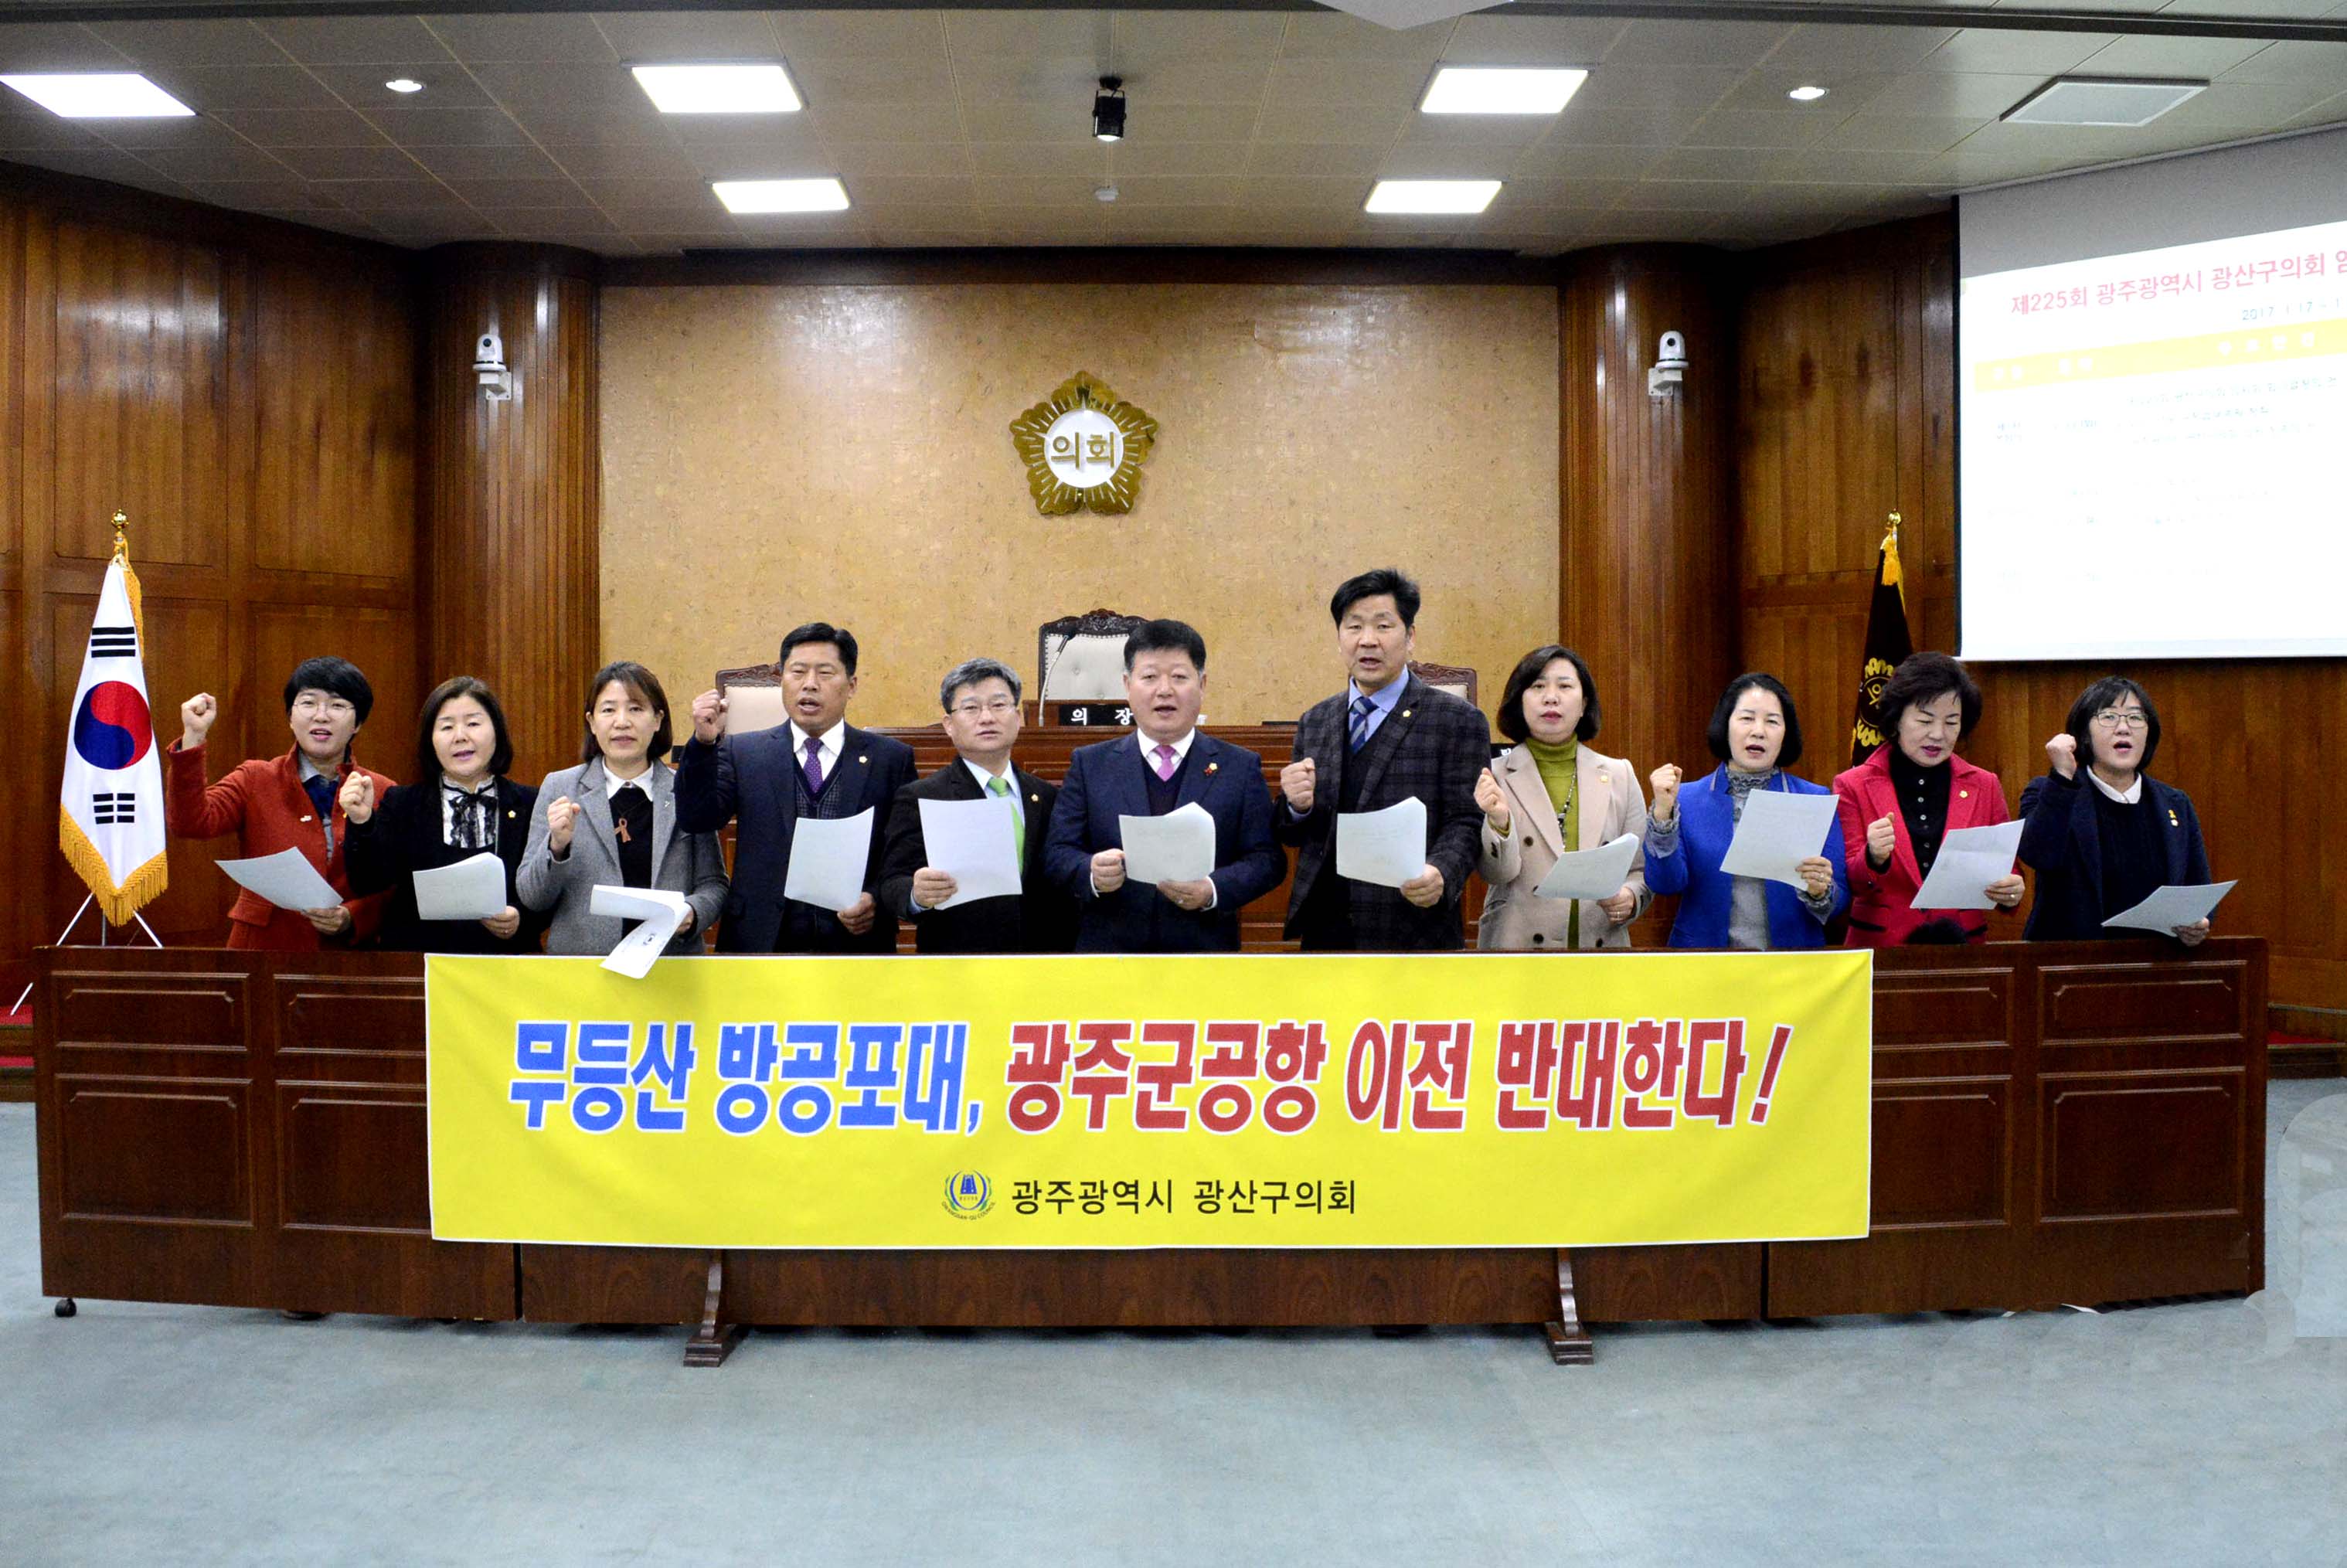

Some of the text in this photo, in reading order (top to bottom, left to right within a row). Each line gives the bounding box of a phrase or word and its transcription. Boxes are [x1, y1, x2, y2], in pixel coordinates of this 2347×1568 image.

[2012, 286, 2087, 315] 제225회
[2097, 270, 2202, 305] 광주광역시
[2213, 253, 2325, 291] 광산구의회
[1050, 431, 1115, 470] 의회
[510, 1020, 1791, 1135] 무등산 방공포대, 광주군공항 이전 반대한다!
[1012, 1179, 1355, 1214] 광주광역시 광산구의회
